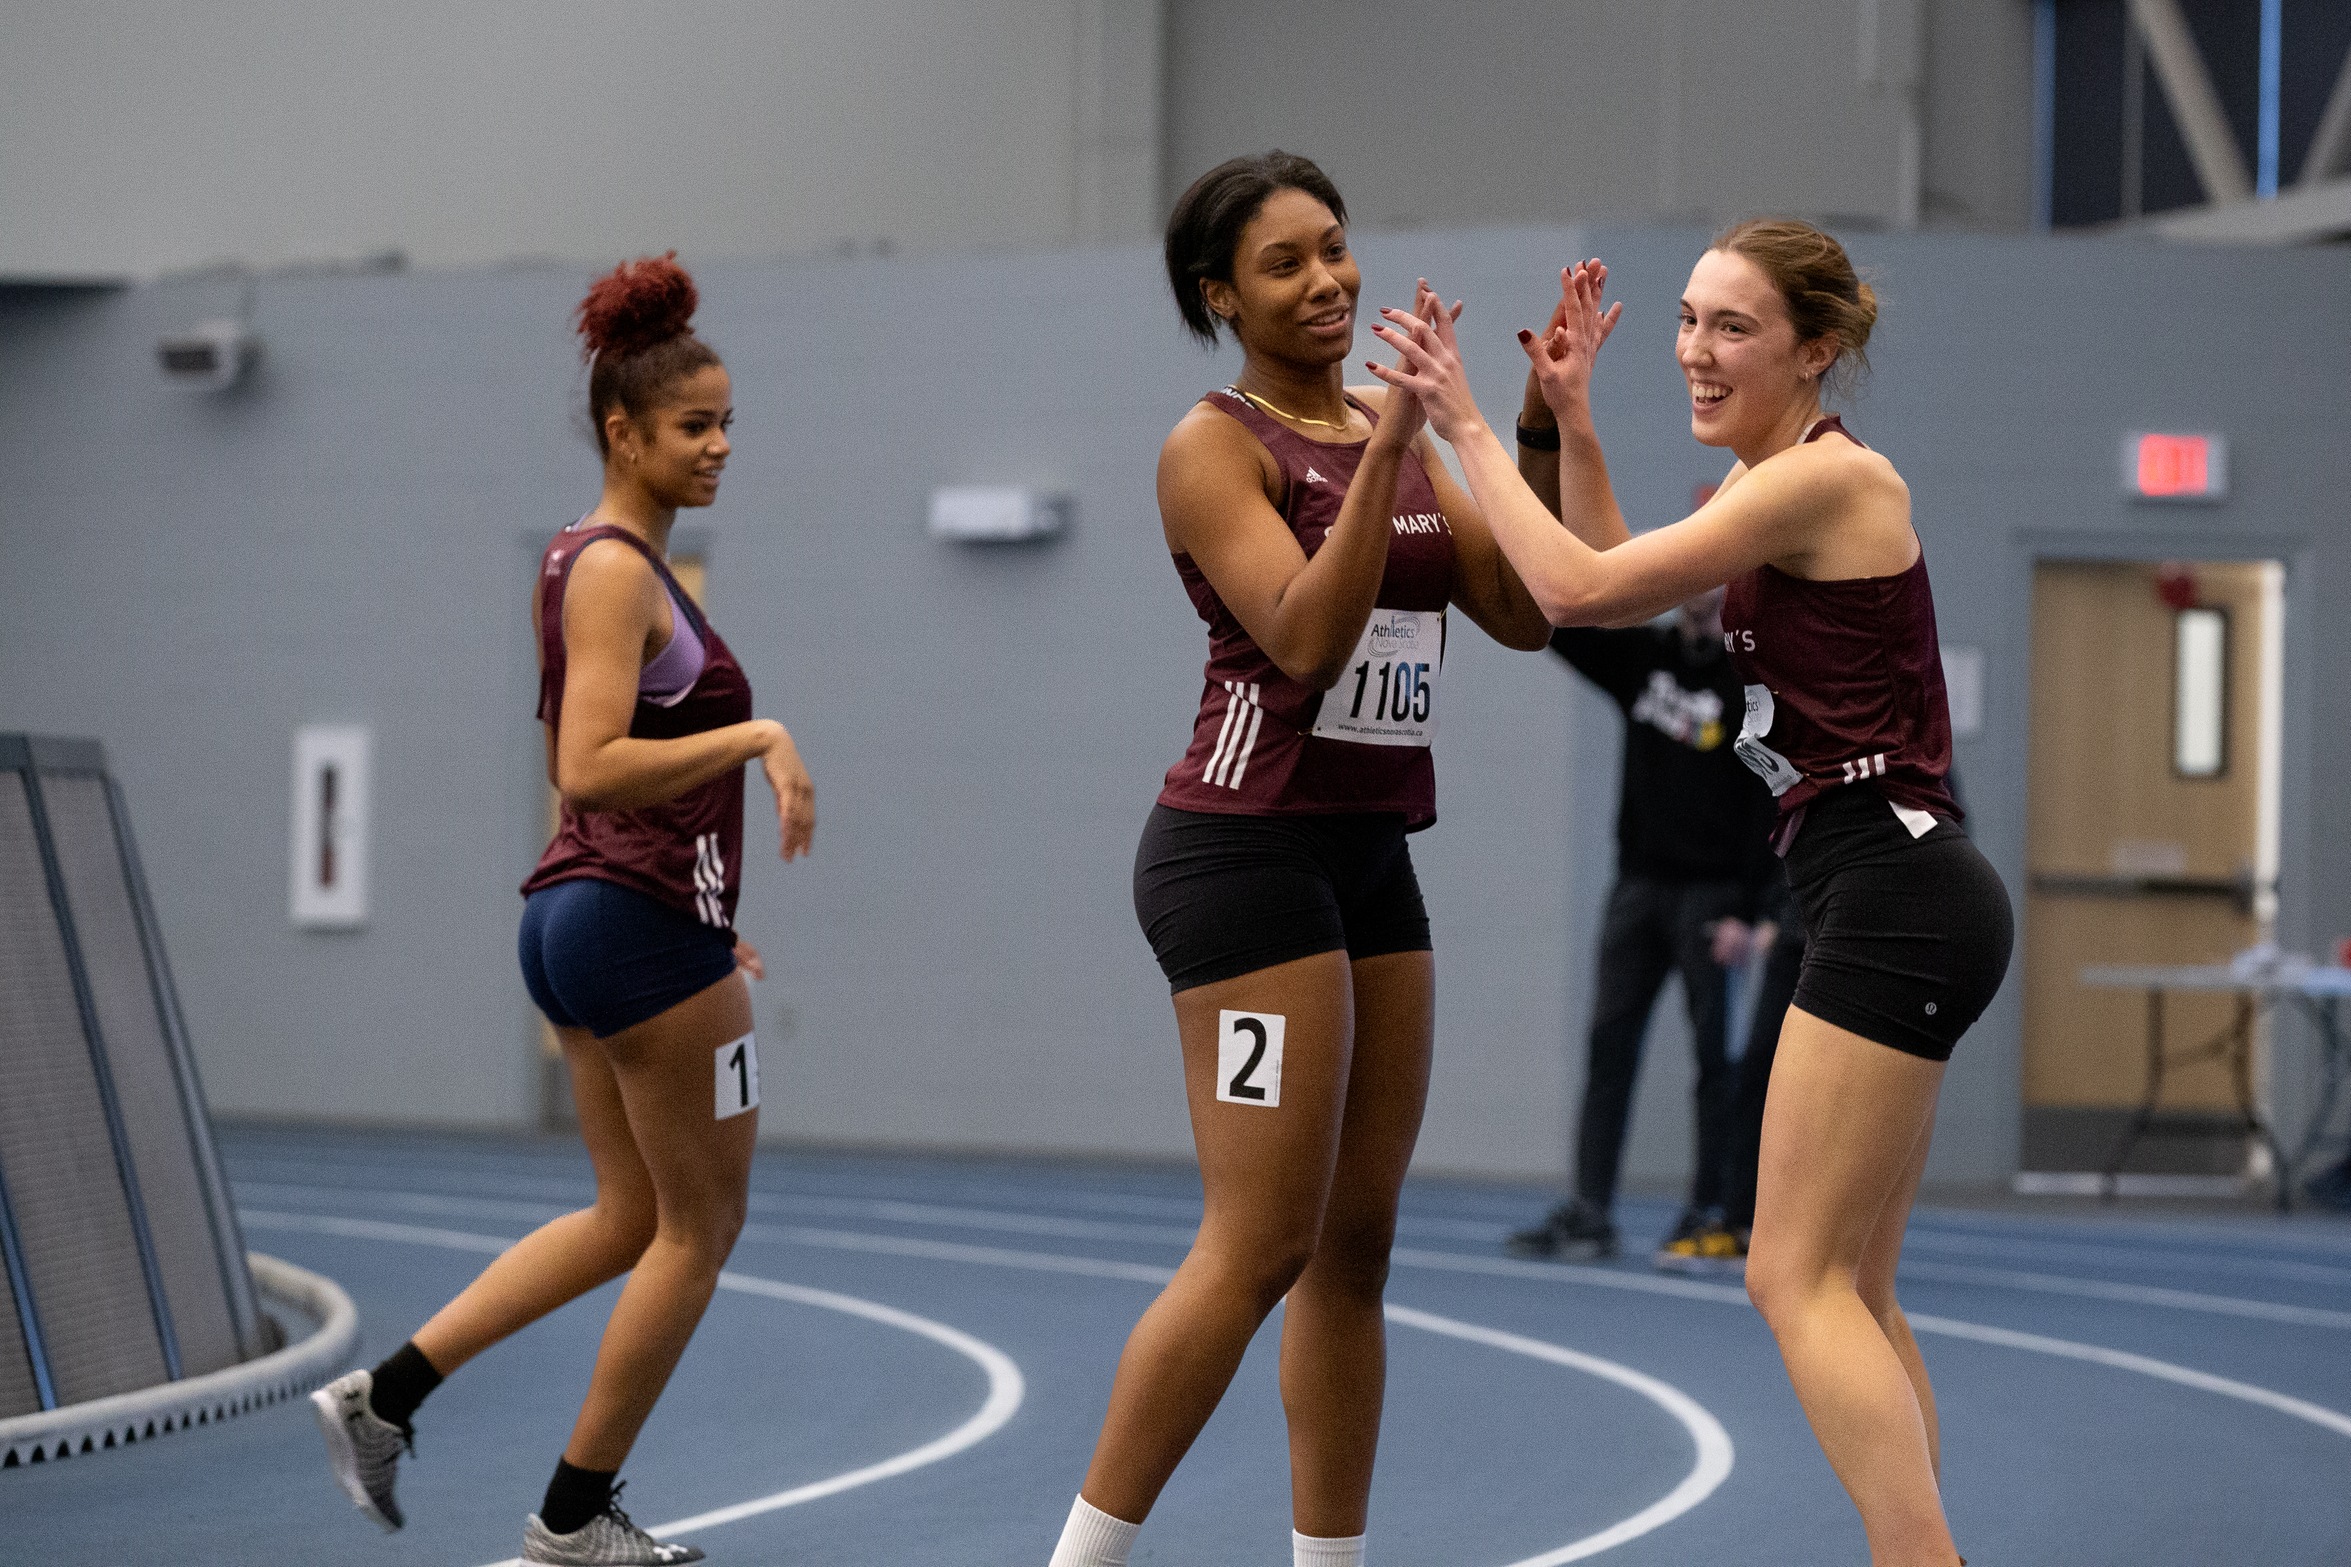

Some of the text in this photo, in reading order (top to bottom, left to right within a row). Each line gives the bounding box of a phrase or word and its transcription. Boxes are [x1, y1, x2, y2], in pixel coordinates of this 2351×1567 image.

[1371, 617, 1415, 639] Athletics
[1350, 660, 1431, 723] 1105
[729, 1042, 749, 1108] 1
[1229, 1017, 1267, 1101] 2
